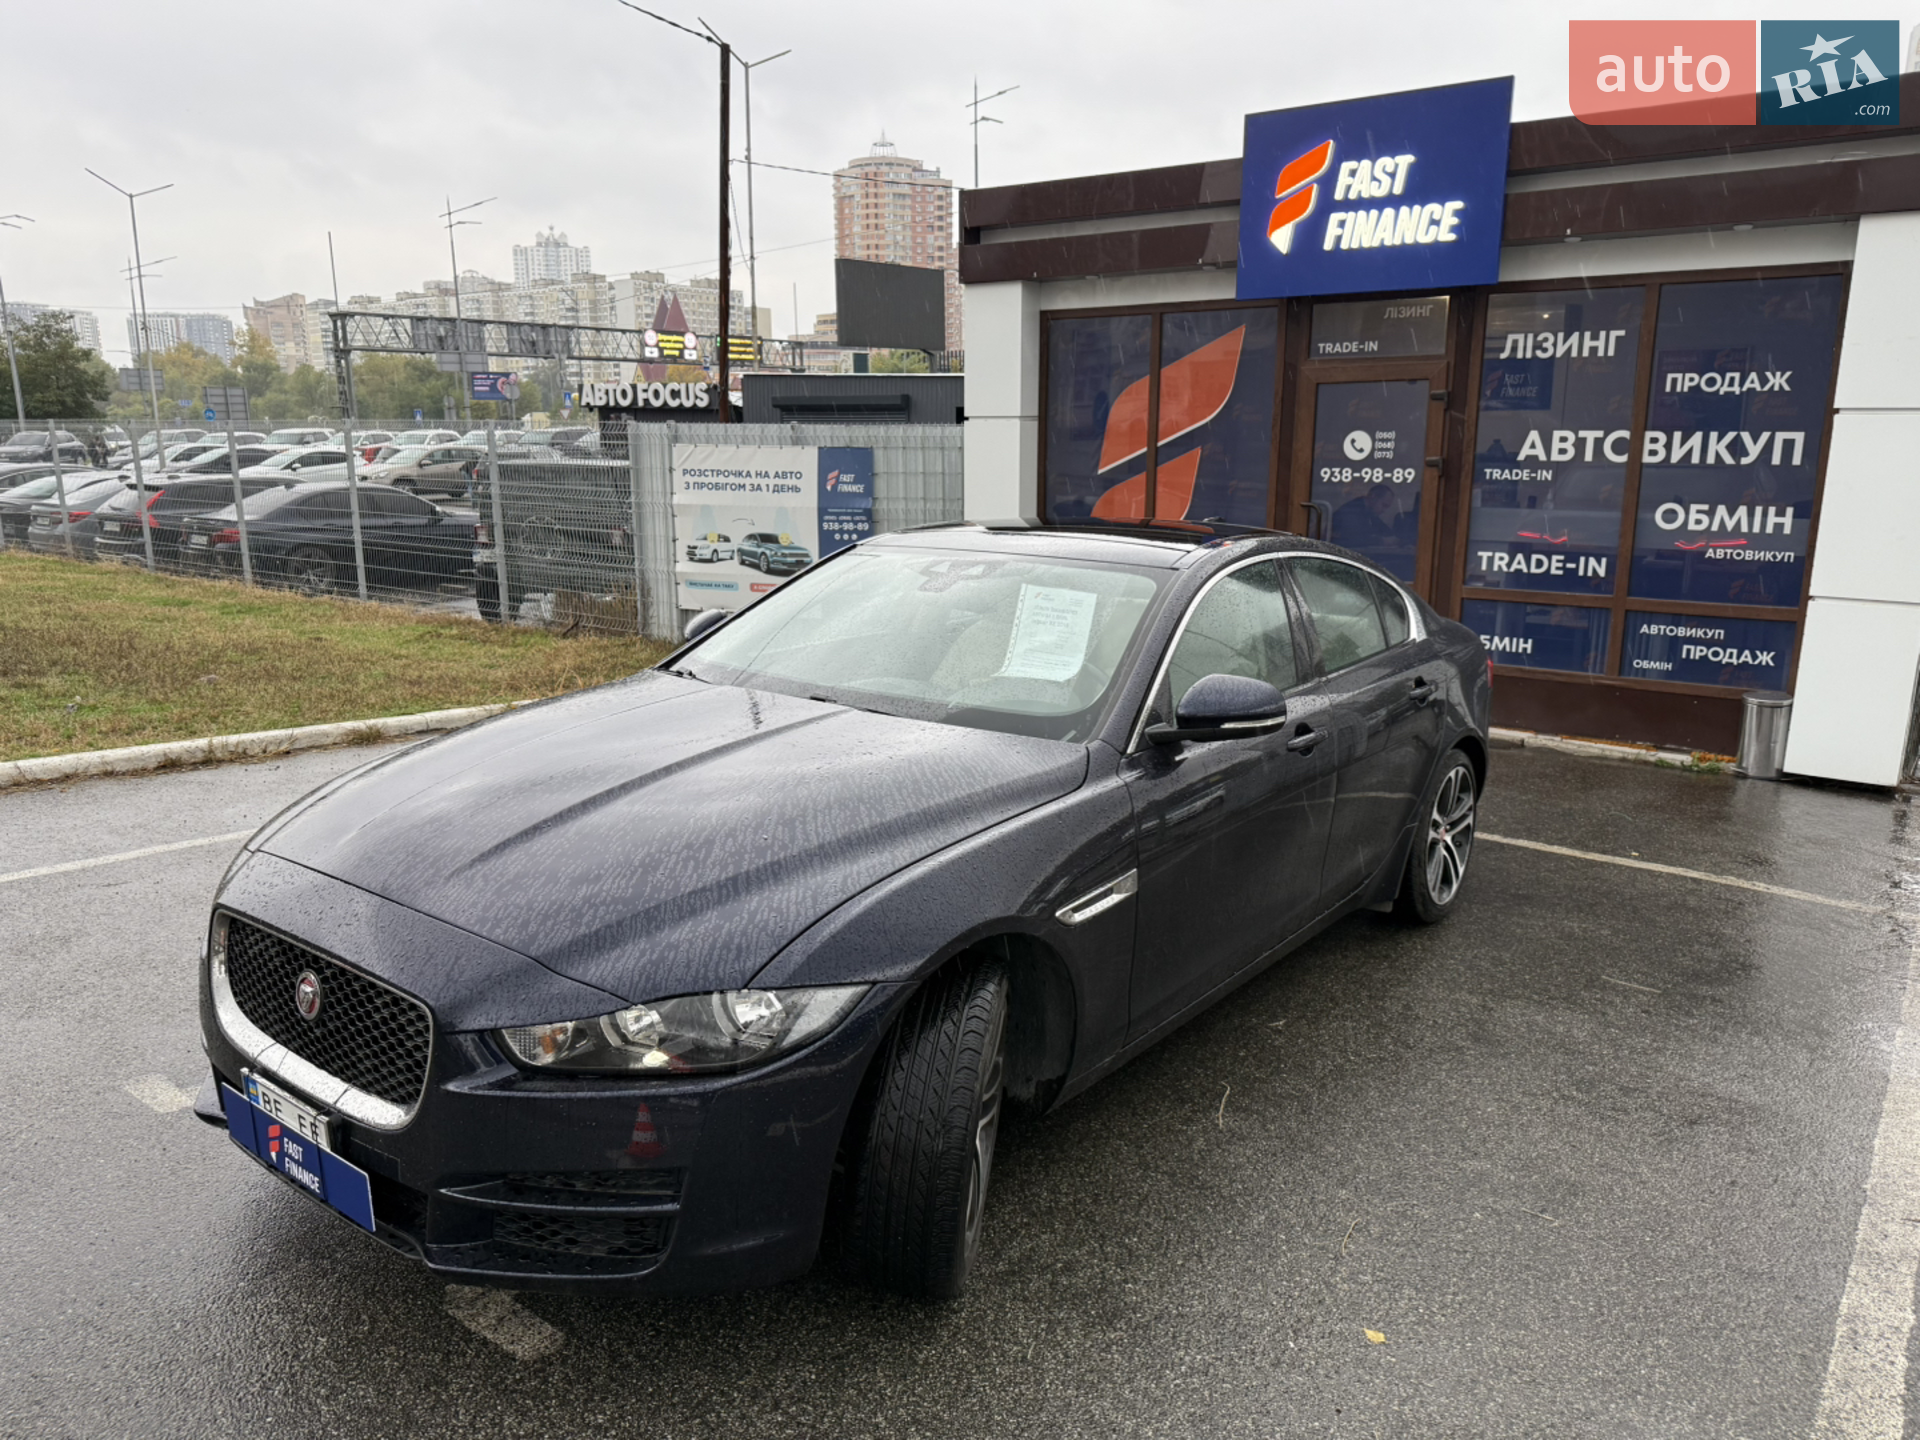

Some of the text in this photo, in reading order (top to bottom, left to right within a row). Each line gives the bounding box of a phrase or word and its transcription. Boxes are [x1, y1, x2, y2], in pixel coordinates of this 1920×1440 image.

[1334, 154, 1416, 201] FAST
[1323, 200, 1465, 251] FINANCE
[1384, 304, 1434, 320] ЛІЗИНГ
[1318, 340, 1379, 354] TRADE-IN
[1500, 330, 1626, 359] ЛІЗИНГ
[1665, 371, 1793, 395] ПРОДАЖ
[581, 382, 710, 408] АВТО FOCUS
[682, 468, 803, 481] РОЗСТРОЧКА НА АВТО
[839, 473, 856, 483] FAST
[1320, 467, 1416, 484] 938-98-89
[1484, 468, 1553, 481] TRADE-IN
[693, 482, 747, 492] ПРОБІГОМ
[748, 483, 763, 493] ЗА
[765, 484, 770, 493] 1
[772, 484, 802, 494] ДЕНЬ
[837, 484, 865, 493] FINANCE
[1654, 502, 1795, 535] ОБМІН
[1477, 552, 1608, 578] TRADE-IN
[1704, 548, 1795, 563] АВТОВИКУП
[1640, 623, 1725, 641] АВТОВИКУП
[1480, 634, 1533, 654] БМІН
[1681, 644, 1776, 667] ПРОДАЖ
[1632, 659, 1673, 672] ОБМІН
[283, 1136, 304, 1163] FAST
[284, 1156, 321, 1194] FINANCE
